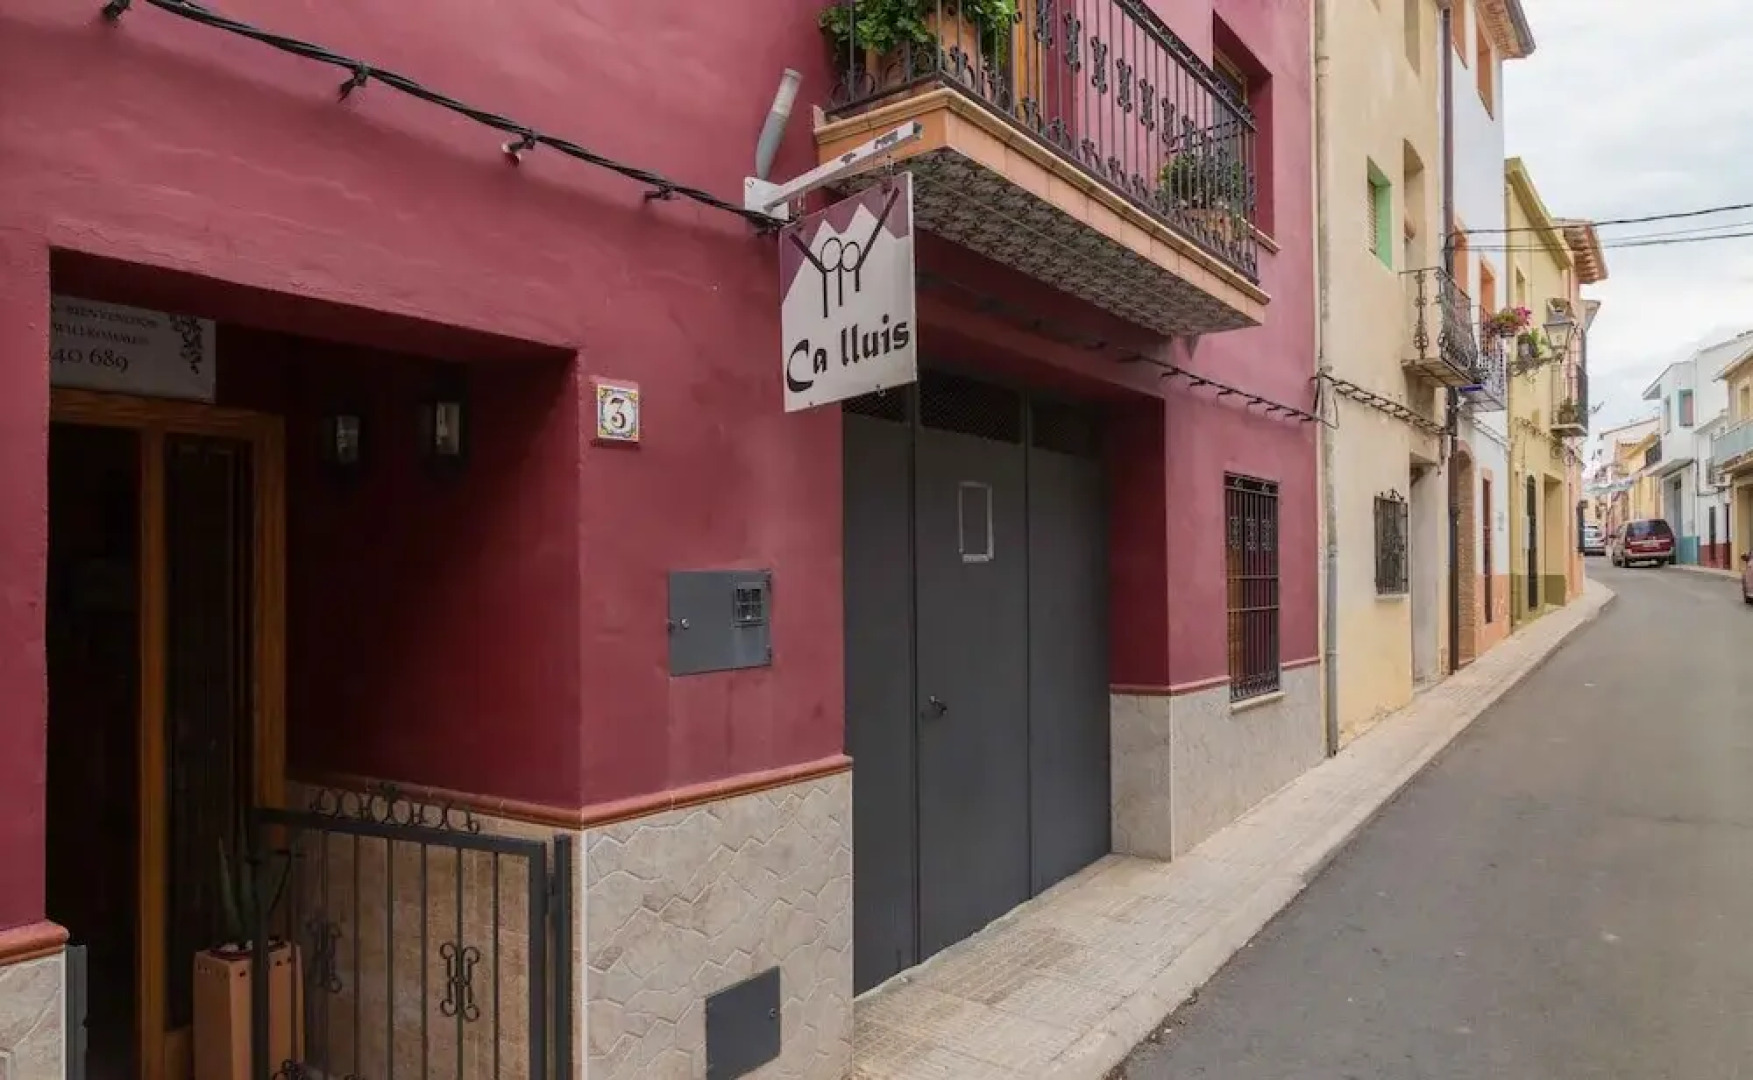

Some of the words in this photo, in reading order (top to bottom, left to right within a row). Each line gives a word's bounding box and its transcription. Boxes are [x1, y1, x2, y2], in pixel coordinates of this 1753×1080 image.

[89, 348, 129, 373] 689
[787, 339, 828, 393] Ca
[841, 314, 909, 366] lluis
[611, 397, 626, 429] 3
